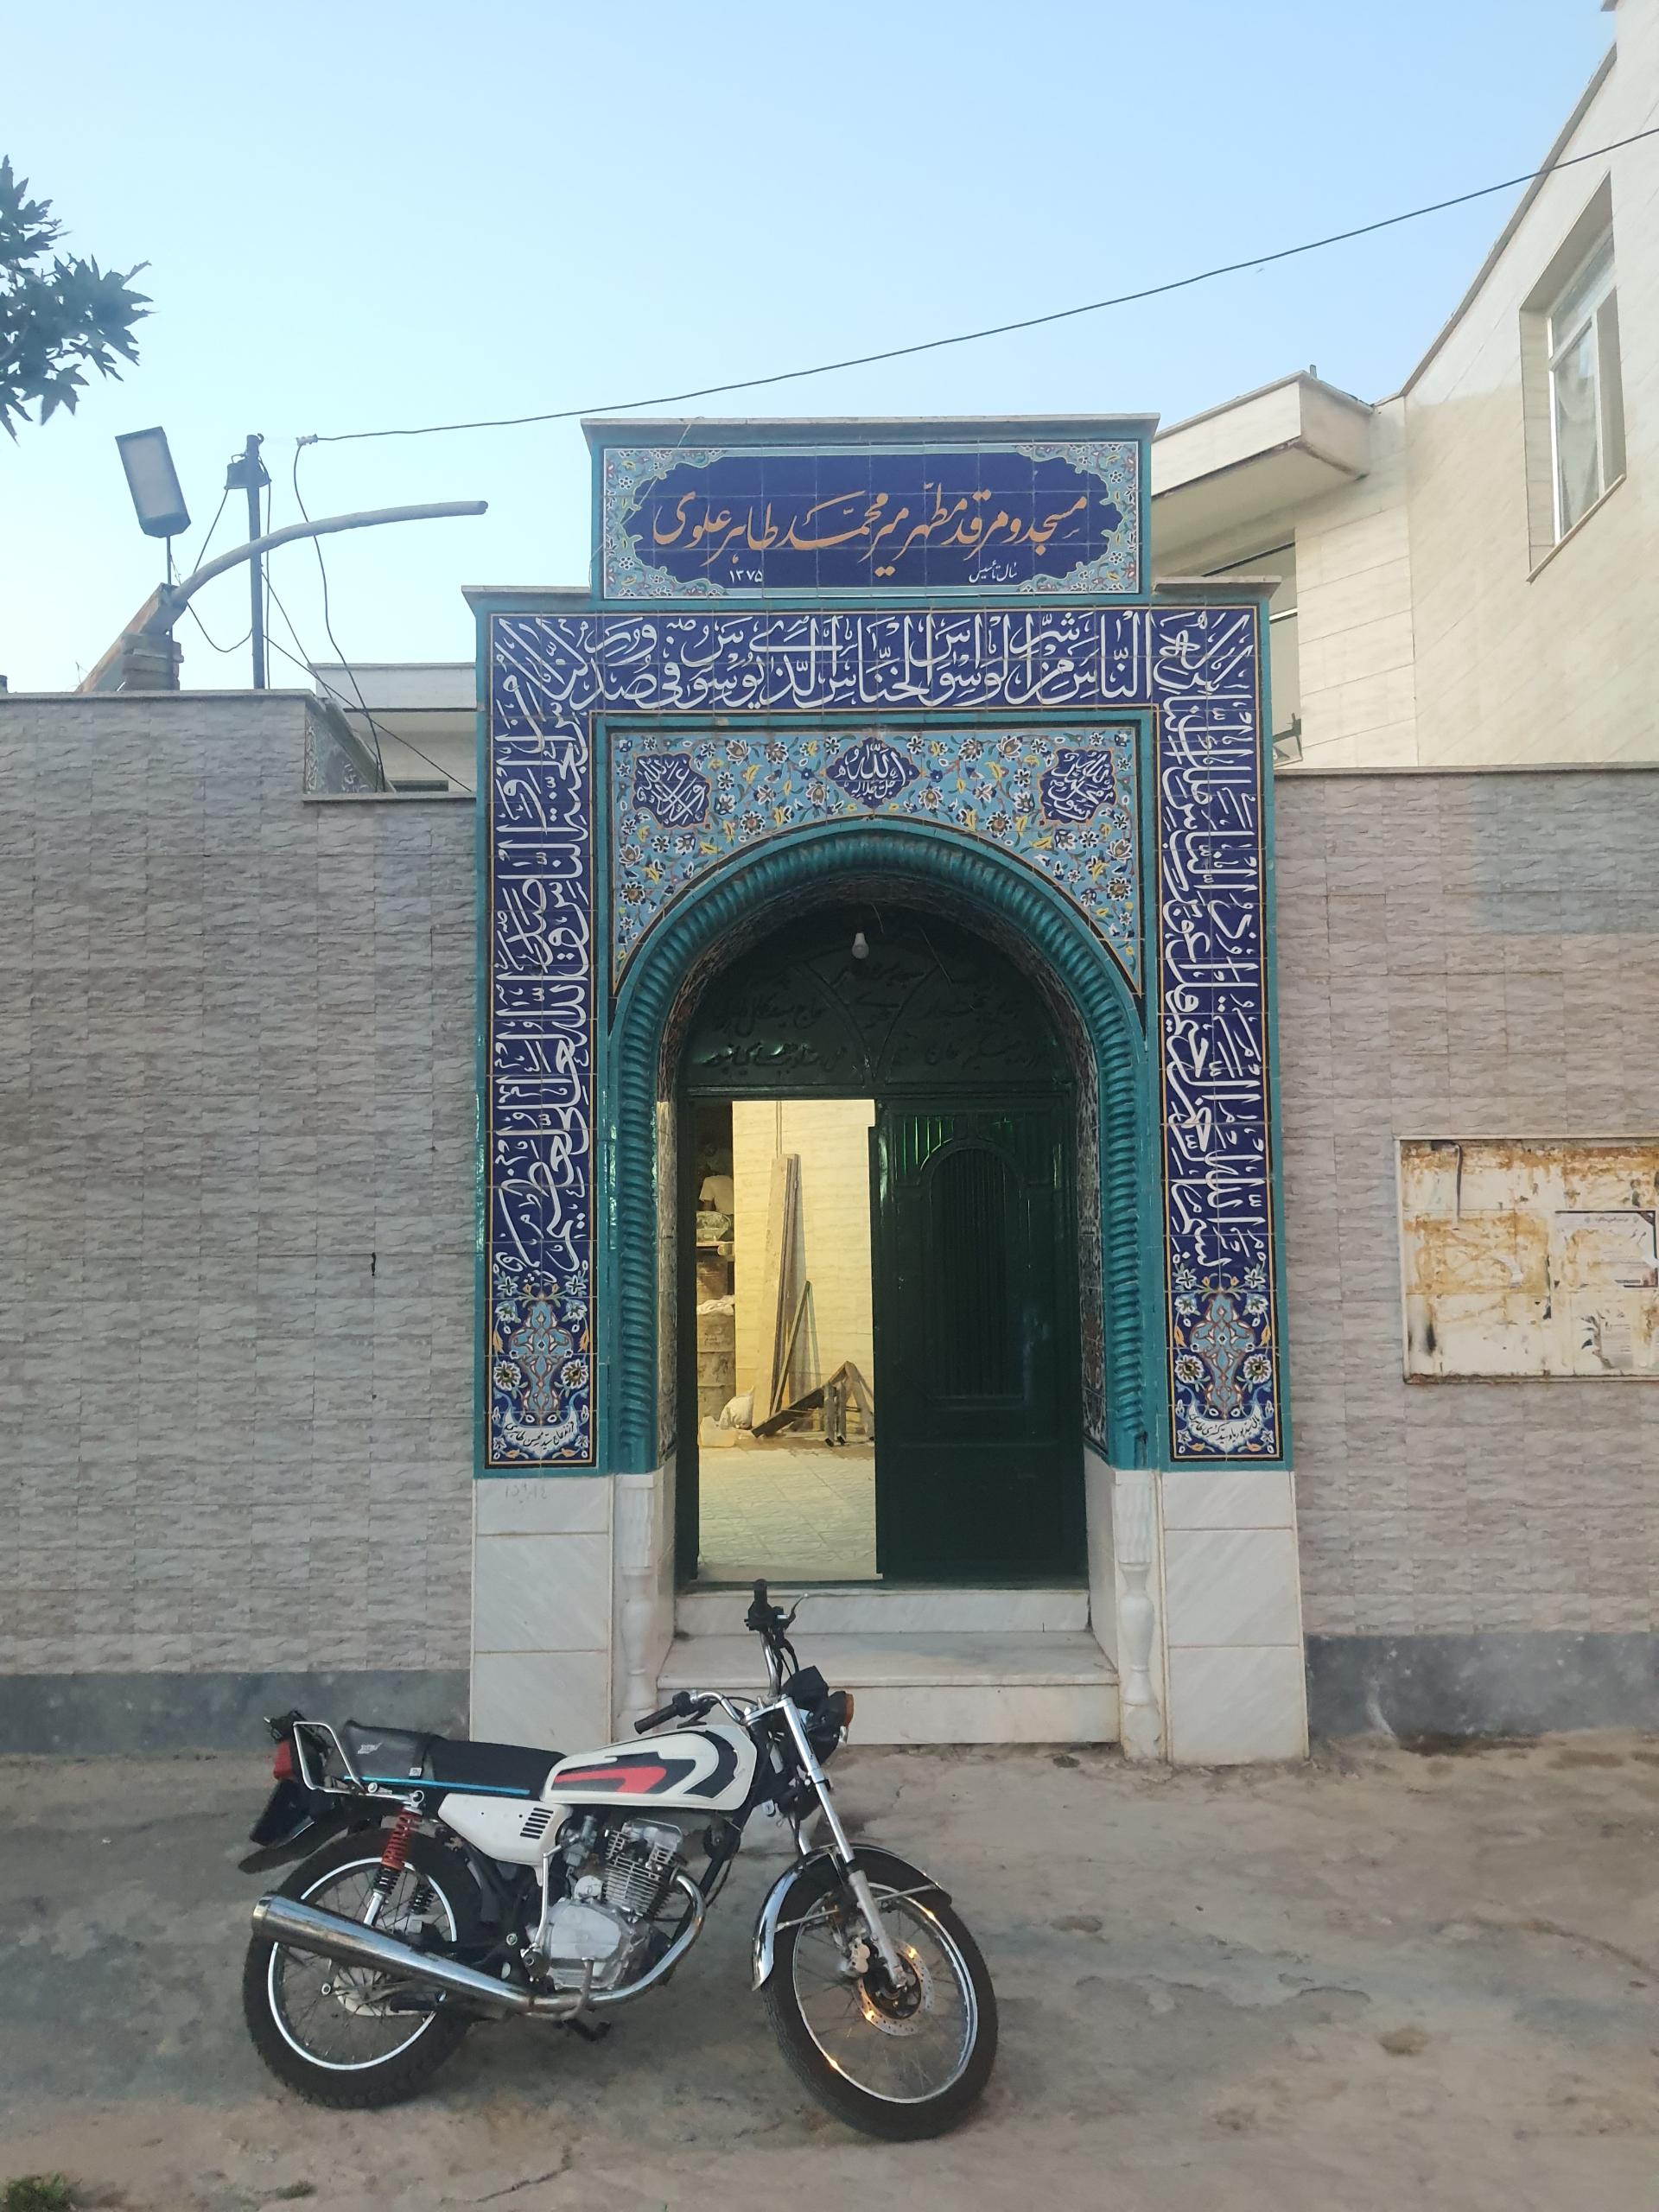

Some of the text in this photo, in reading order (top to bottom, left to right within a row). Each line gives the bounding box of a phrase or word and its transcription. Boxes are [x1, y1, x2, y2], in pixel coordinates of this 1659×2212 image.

[653, 491, 733, 549] علوی
[700, 503, 779, 567] طاهر
[775, 490, 889, 550] محمد
[858, 507, 910, 576] میر
[940, 489, 1009, 561] مرقد
[1001, 518, 1022, 543] و
[1014, 496, 1087, 556] مسجد
[847, 748, 906, 787] الله
